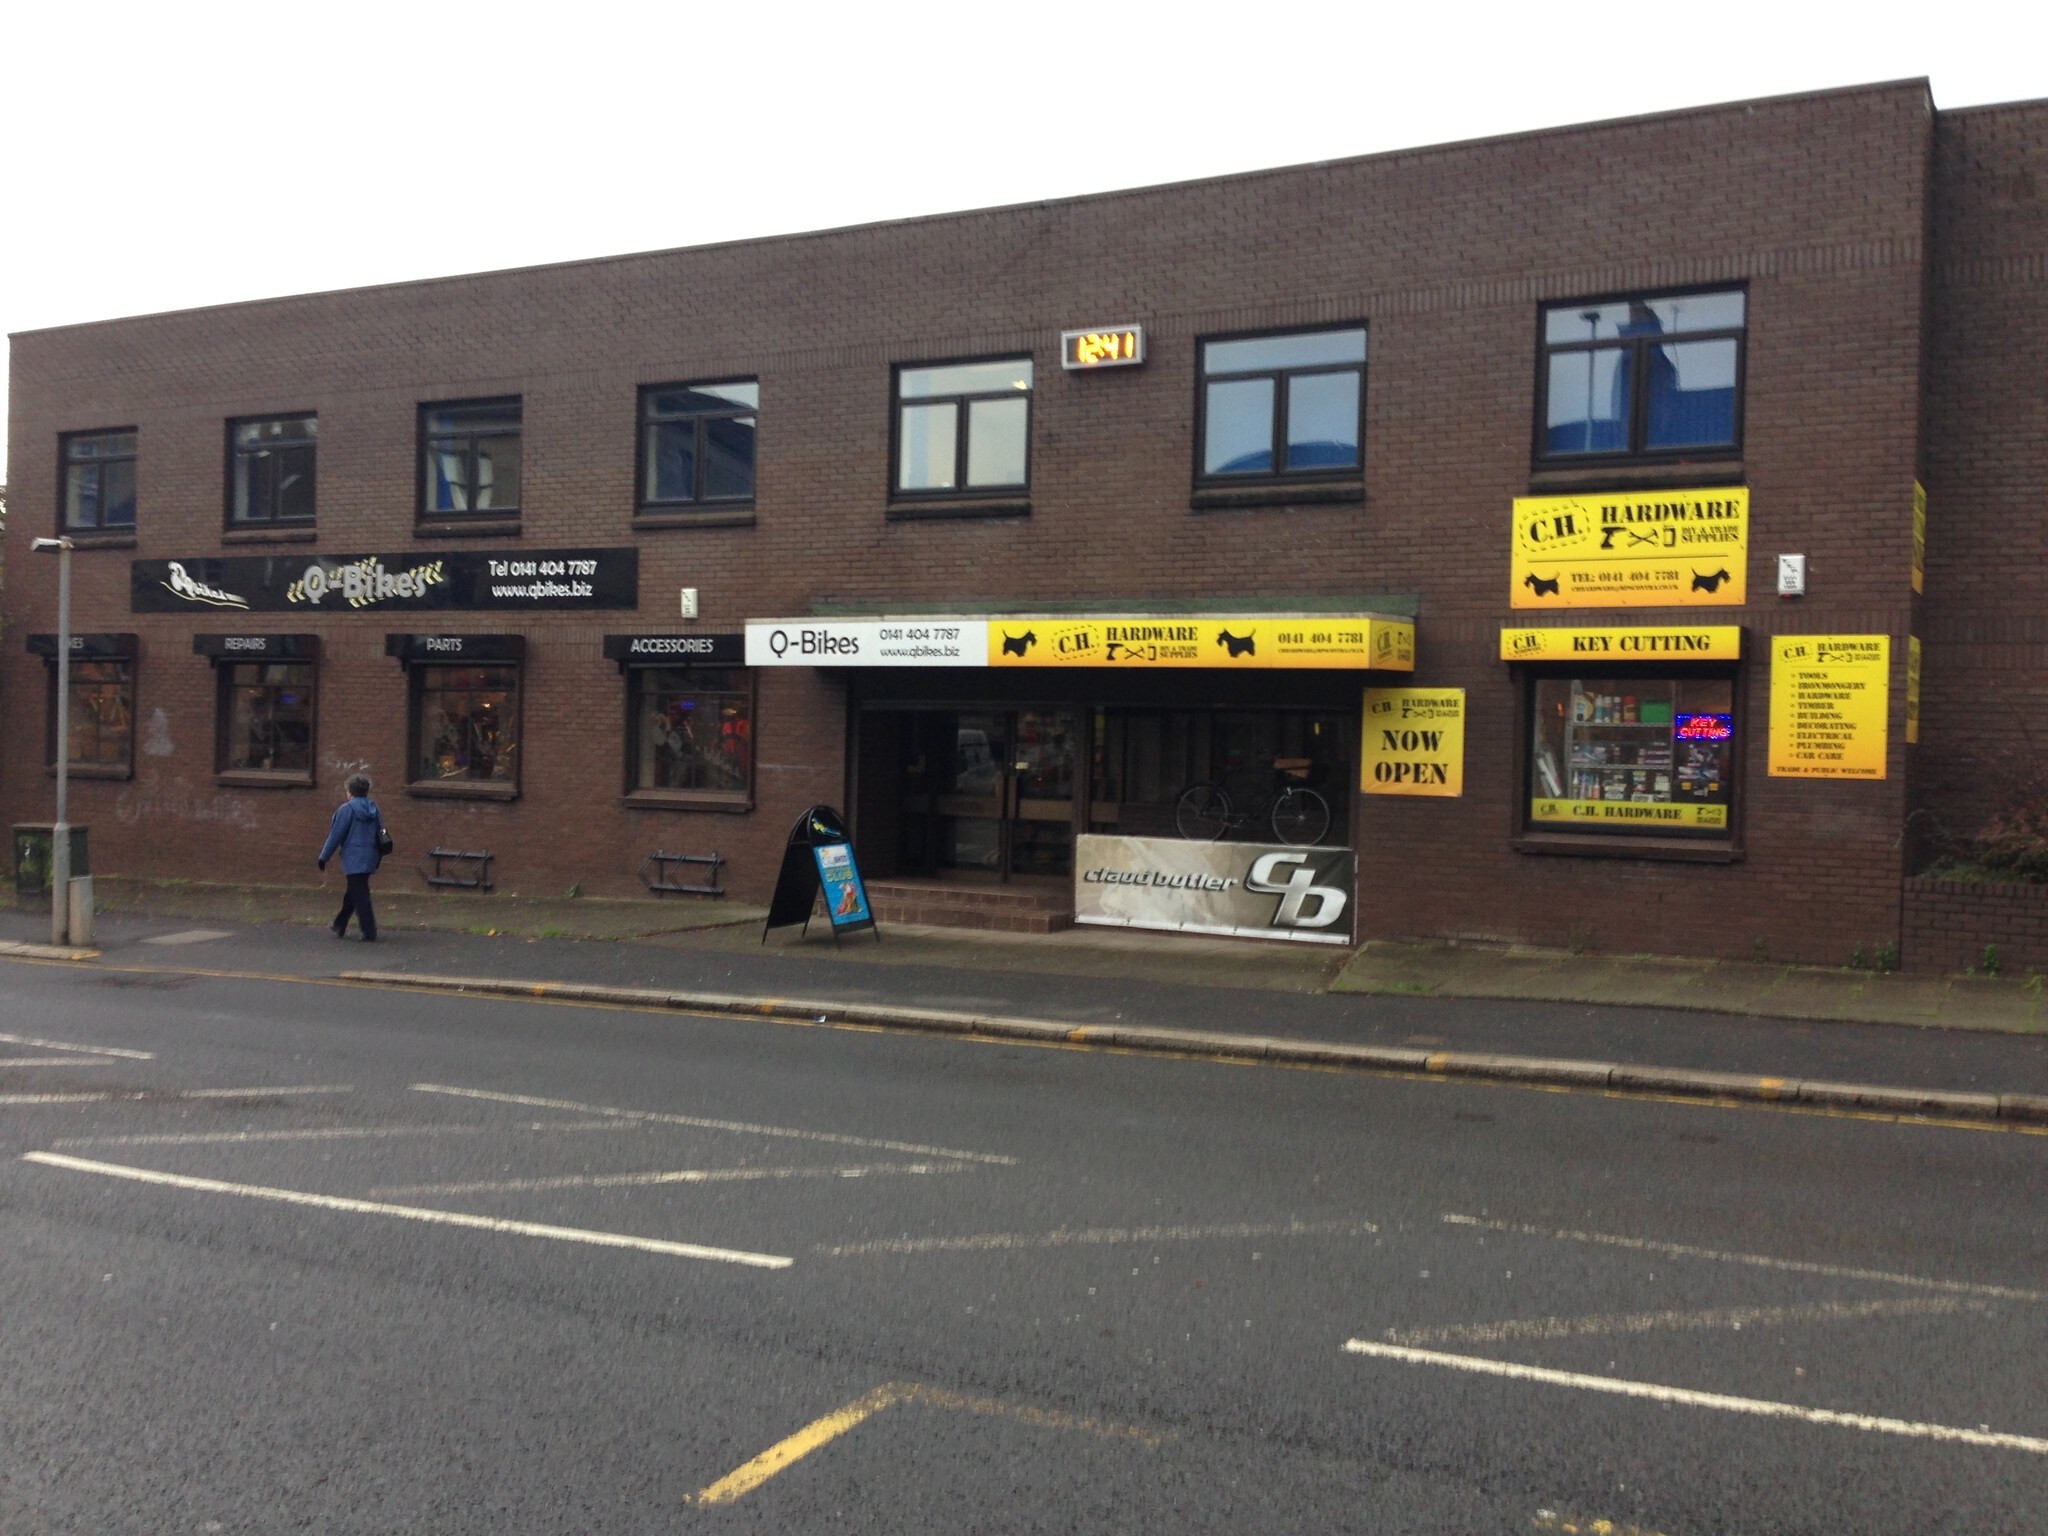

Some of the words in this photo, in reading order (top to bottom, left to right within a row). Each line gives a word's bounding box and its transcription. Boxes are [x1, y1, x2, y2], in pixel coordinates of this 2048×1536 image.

[1600, 500, 1739, 523] HARDWARE
[1681, 533, 1739, 543] SUPPLIES
[488, 560, 508, 576] Tel
[510, 560, 537, 576] 0141
[538, 560, 566, 575] 404
[567, 560, 598, 575] 7787
[1599, 572, 1623, 582] 0141
[1629, 571, 1649, 581] 404
[1655, 570, 1679, 580] 7781
[303, 563, 427, 604] Q-Bikes
[491, 580, 593, 600] www.qbikes.biz
[879, 628, 903, 641] 0141
[906, 628, 929, 640] 404
[933, 628, 960, 640] 7787
[1106, 626, 1198, 642] HARDWARE
[1278, 632, 1304, 644] 0141
[1309, 632, 1331, 644] 404
[1337, 632, 1364, 644] 7781
[224, 637, 266, 650] REPAIRS
[426, 638, 462, 651] PARTS
[630, 638, 714, 653] ACCESSORIES
[769, 630, 859, 659] Q-Bikes
[1572, 636, 1613, 651] KEY
[1619, 635, 1711, 651] CUTTING
[1817, 643, 1881, 651] HARDWARE
[879, 645, 960, 659] www.qbikes.biz
[1798, 672, 1828, 680] TOOLS
[1797, 682, 1866, 690] IRONMONGERY
[1797, 692, 1851, 700] HARDWARE
[1402, 699, 1460, 708] HARDWARE
[1690, 718, 1717, 727] KEY
[1796, 722, 1857, 730] DECORATING
[1680, 728, 1728, 737] CUTTING
[1796, 732, 1855, 740] ELECTRICAL
[1381, 730, 1444, 752] NOW
[1796, 742, 1845, 750] PLUMBING
[1818, 752, 1843, 760] CARE
[1374, 761, 1448, 784] OPEN
[1605, 807, 1682, 820] HARDWARE
[1084, 867, 1151, 887] claud
[1152, 870, 1239, 892] butler
